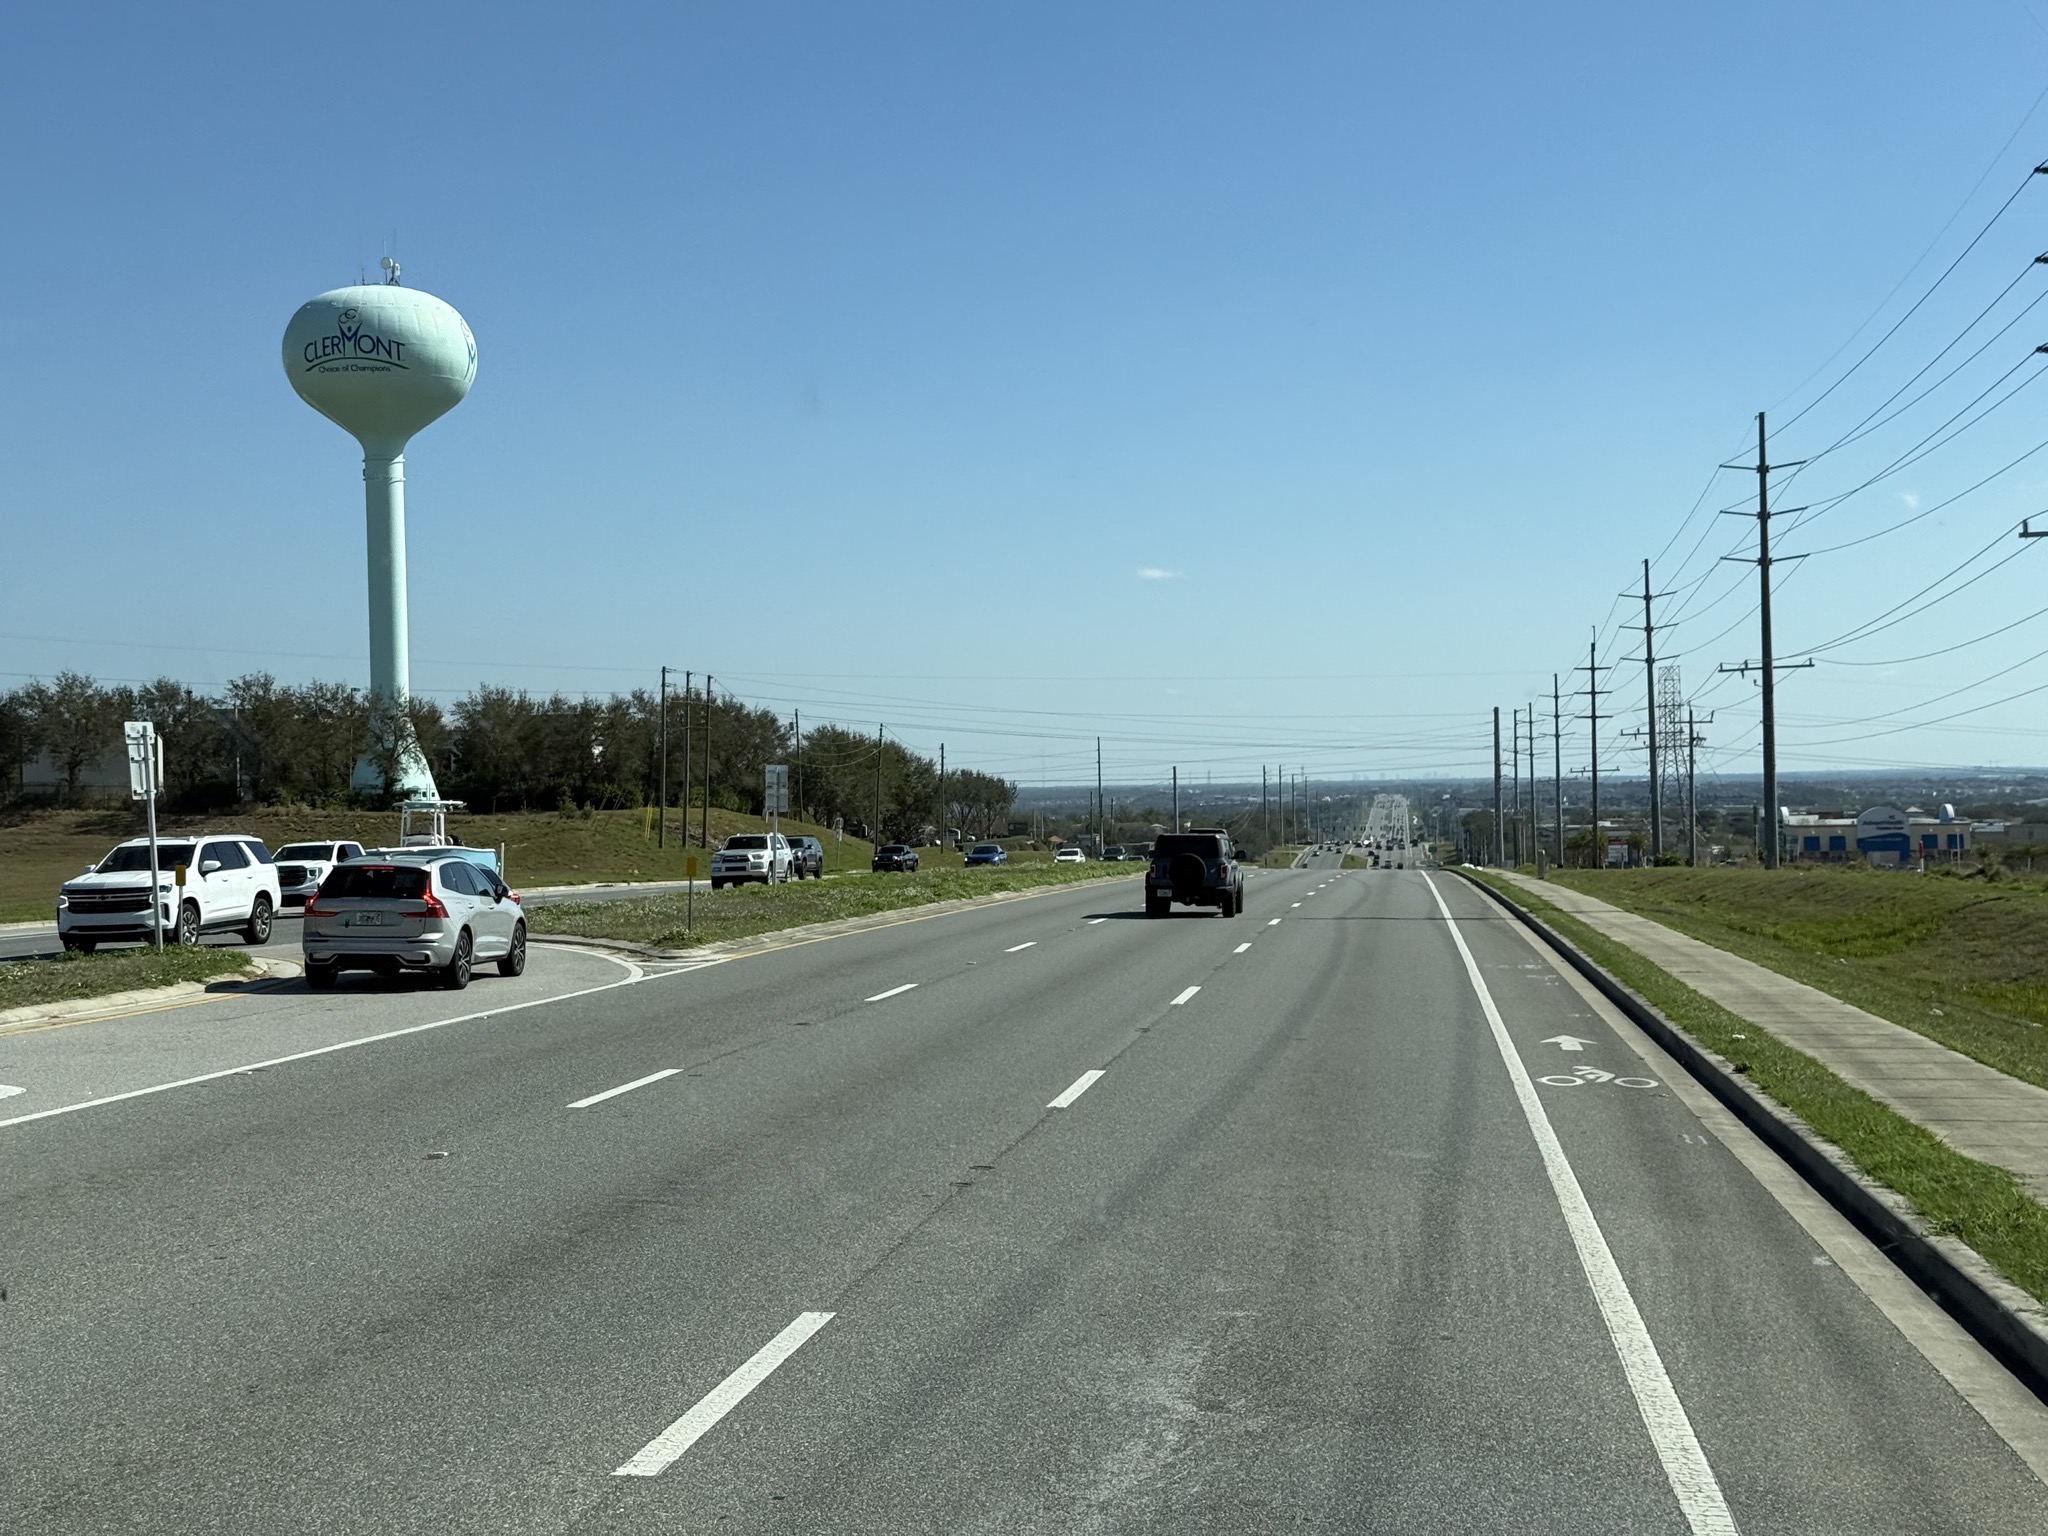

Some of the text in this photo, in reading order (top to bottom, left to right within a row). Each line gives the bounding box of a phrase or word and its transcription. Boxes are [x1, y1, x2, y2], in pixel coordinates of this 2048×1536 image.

[304, 322, 405, 363] CLERMONT
[318, 364, 391, 374] Choice of Champions
